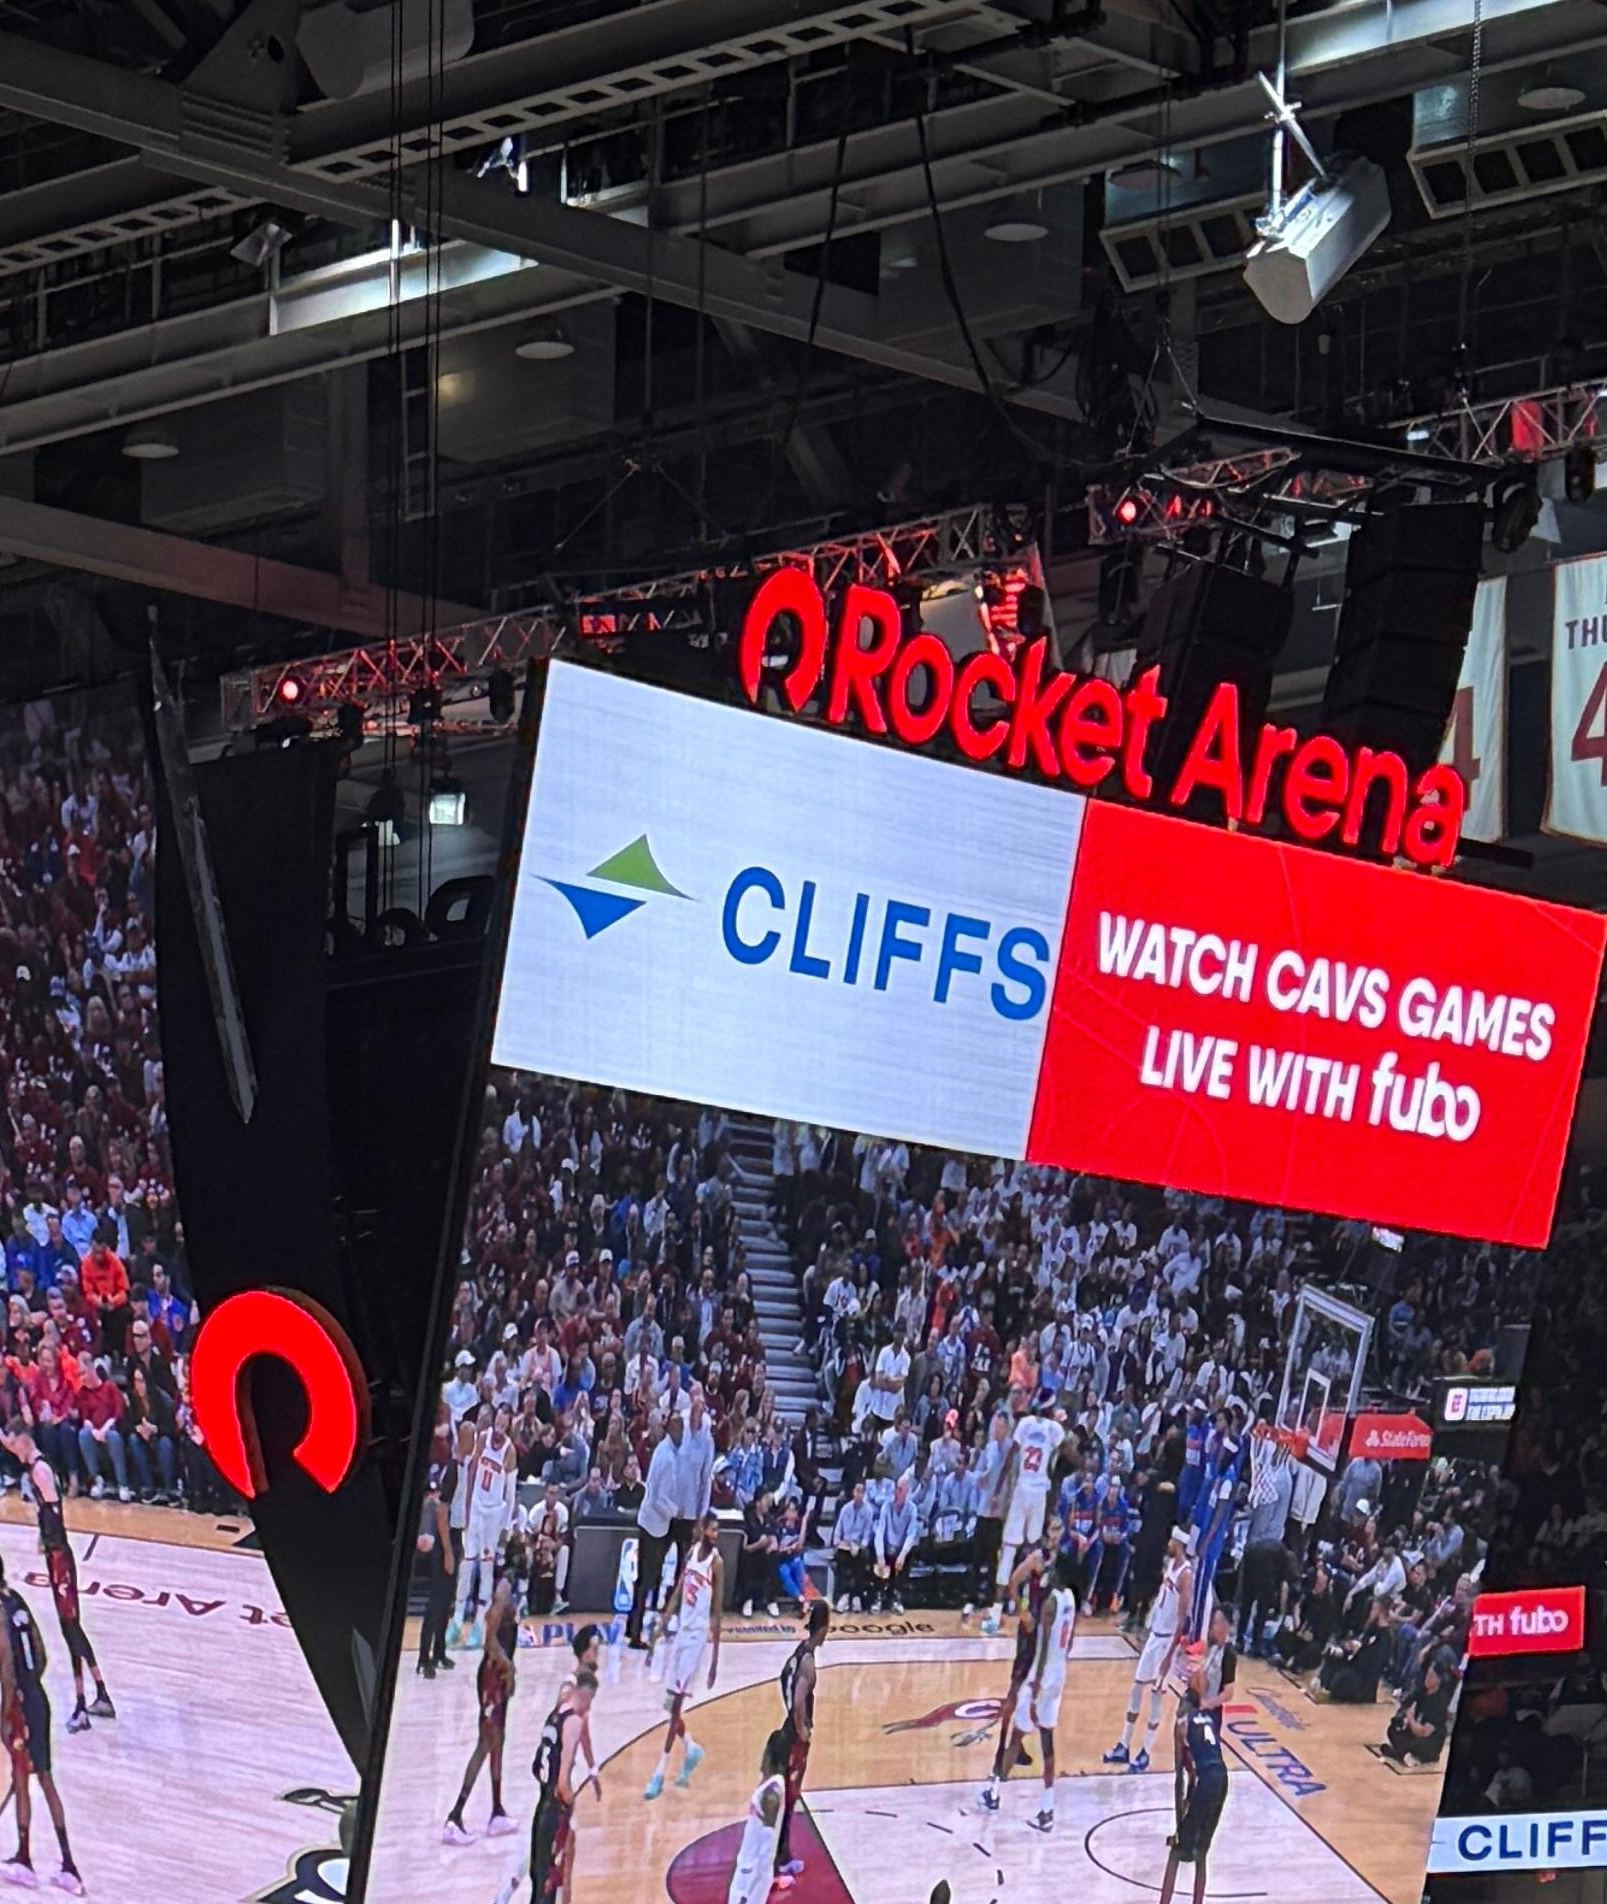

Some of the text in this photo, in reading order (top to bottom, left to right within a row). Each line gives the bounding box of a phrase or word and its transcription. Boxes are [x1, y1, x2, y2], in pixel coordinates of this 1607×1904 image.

[827, 585, 1470, 869] Rocket Arena
[721, 865, 1051, 1021] CLIFFS
[1099, 911, 1556, 1061] WATCH CAVS GAMES
[1140, 1025, 1481, 1142] LIVE WITH fubo
[1509, 1605, 1569, 1635] fubo
[1226, 1719, 1326, 1797] ULTRA
